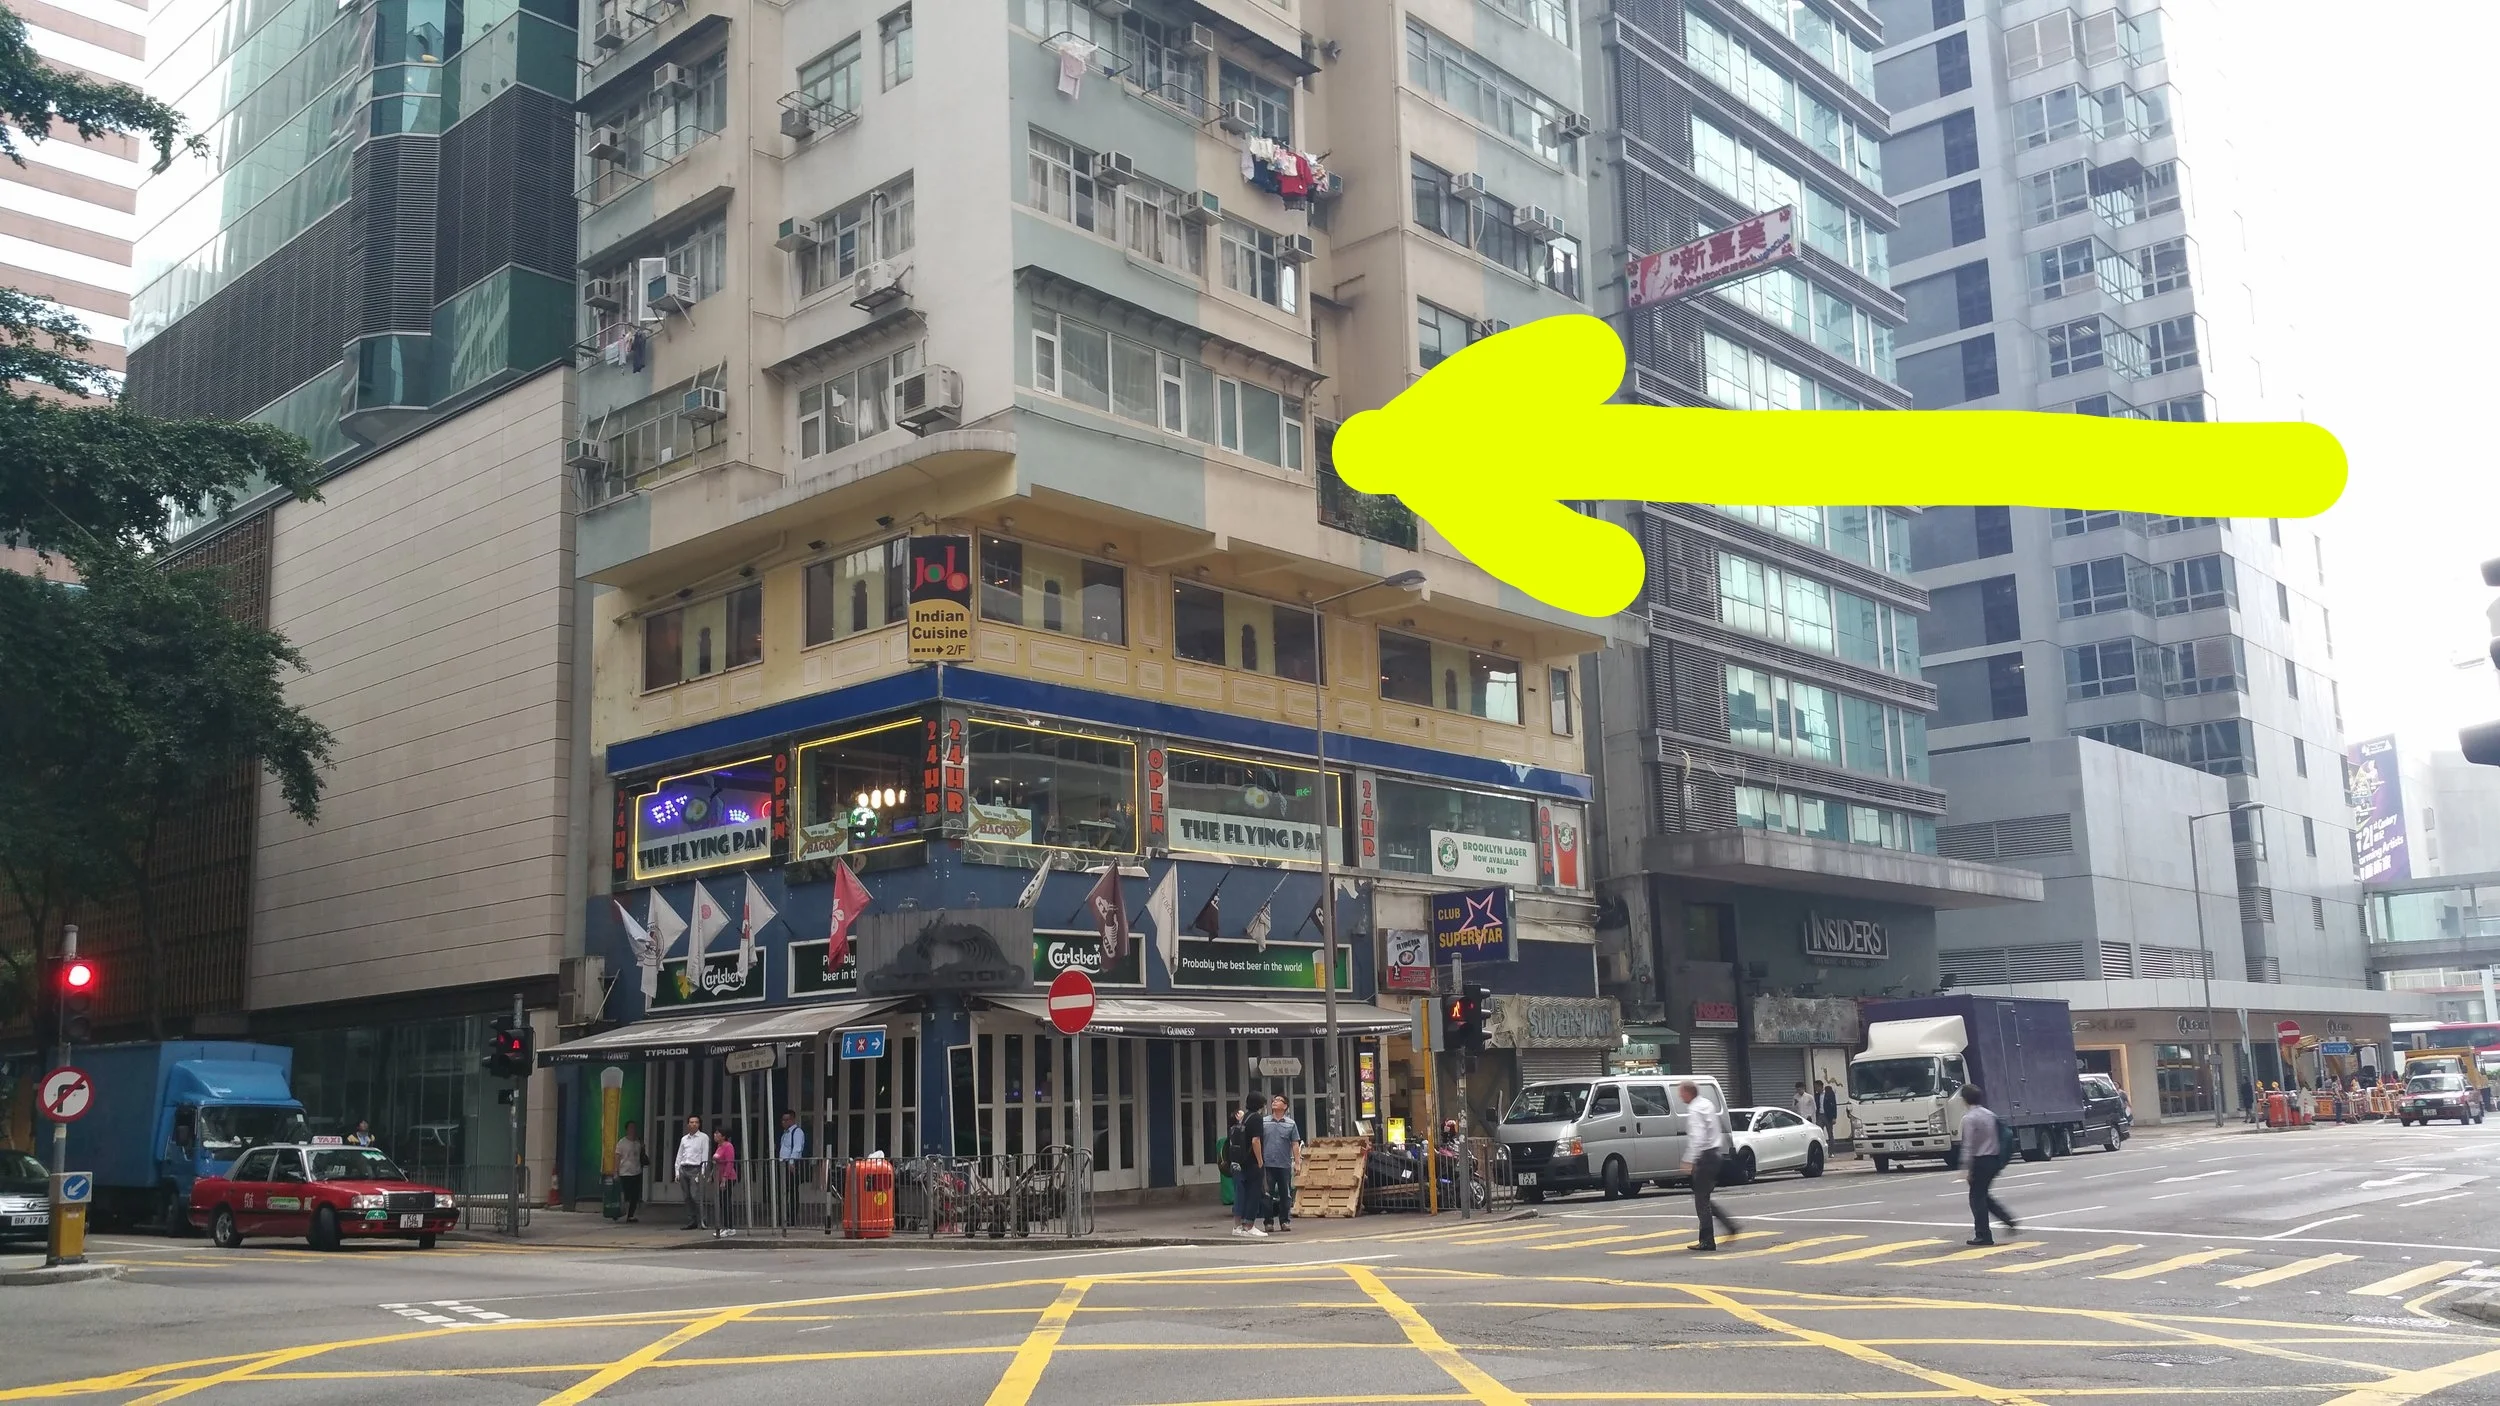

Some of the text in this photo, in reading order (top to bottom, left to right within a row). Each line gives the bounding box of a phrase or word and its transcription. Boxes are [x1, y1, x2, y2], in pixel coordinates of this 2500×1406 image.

[915, 610, 965, 622] Indian
[911, 626, 968, 640] Cuisine
[946, 644, 967, 656] 2/F
[980, 823, 1018, 837] BACON
[1180, 818, 1221, 842] THE
[1223, 823, 1290, 850] FLYING
[638, 826, 767, 872] THE FLYING PAN
[807, 839, 836, 854] BACON
[1462, 841, 1528, 857] BROOKLYN LAGER
[1472, 854, 1519, 866] NOW AVAILABLE
[1486, 866, 1508, 875] ON TAP
[1438, 908, 1461, 921] CLUB
[1439, 928, 1503, 948] SUPERSTAR
[1811, 910, 1882, 955] INSIDERS
[1182, 957, 1303, 972] Probably the best beer in the world
[822, 970, 840, 982] beer
[841, 968, 849, 980] in
[1527, 1004, 1613, 1039] SUPERSTAR
[1167, 1025, 1195, 1036] GUINNESS
[1229, 1027, 1279, 1035] TYPHOON
[644, 1047, 689, 1057] TYPHOON
[710, 1044, 735, 1055] GUINNESS
[318, 1136, 341, 1144] TAXI
[14, 1216, 26, 1224] BK
